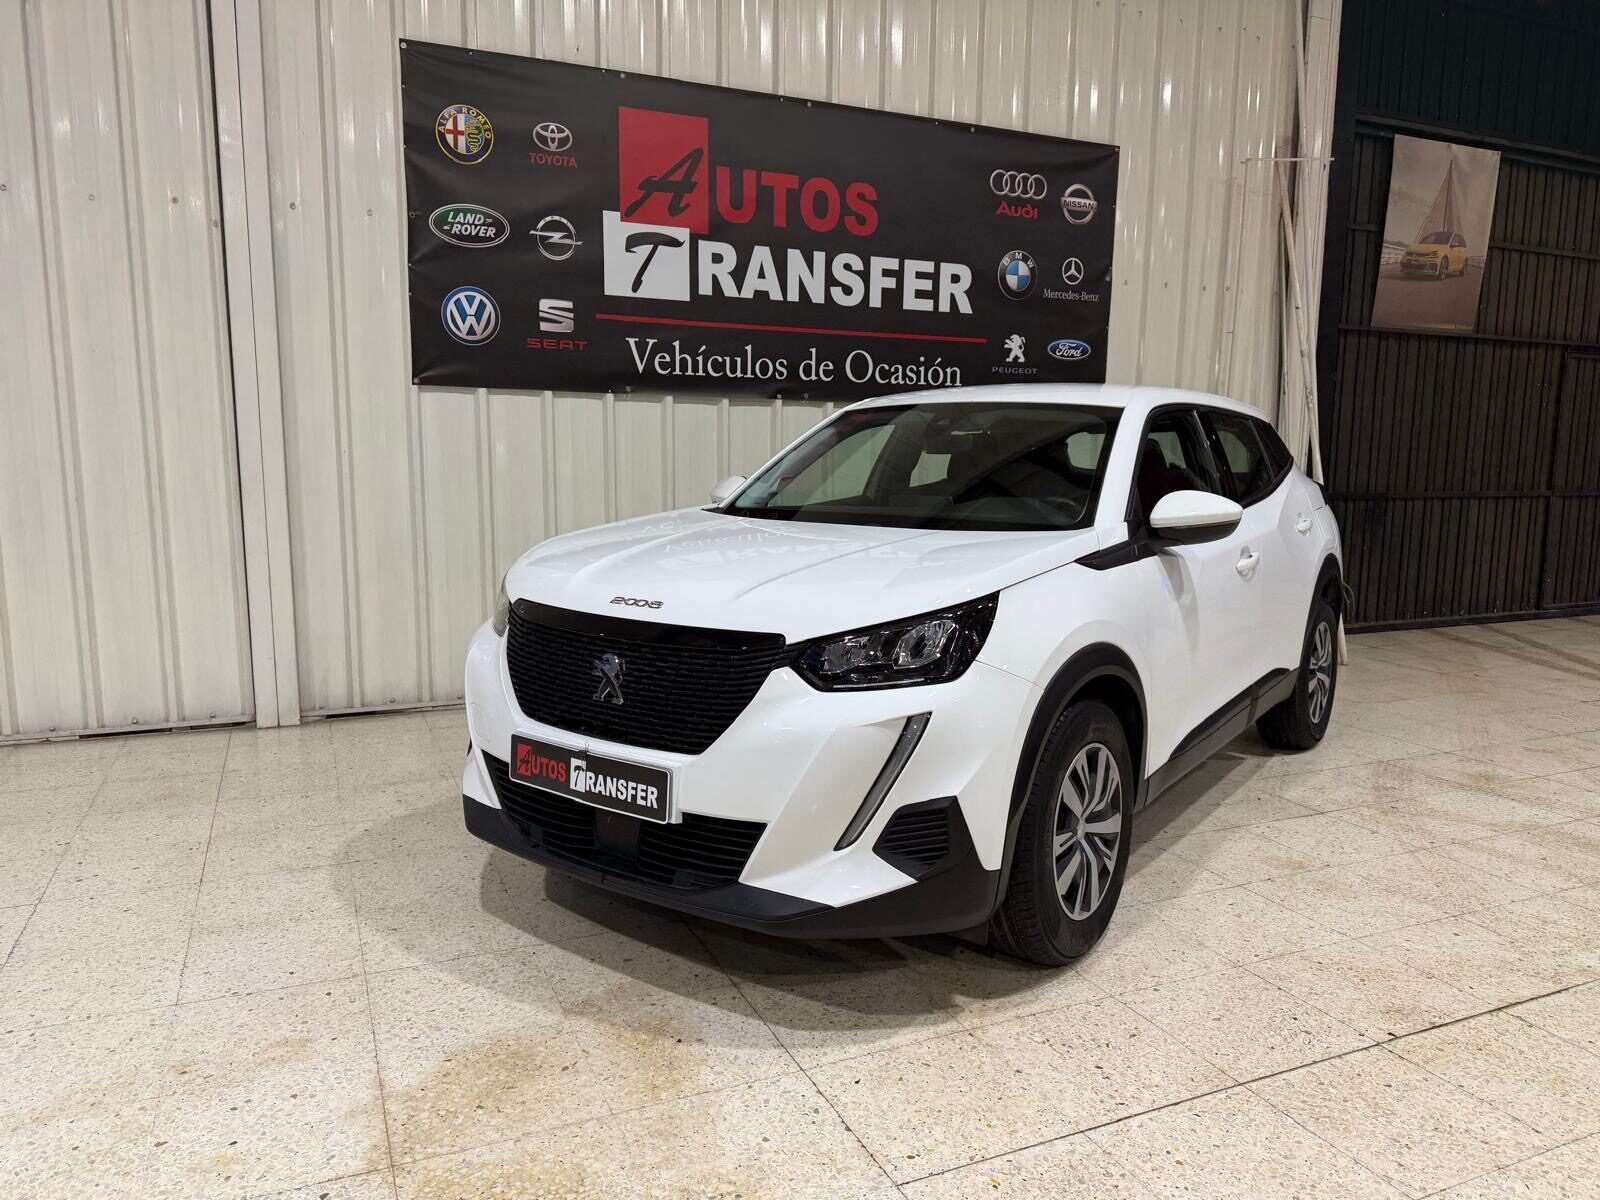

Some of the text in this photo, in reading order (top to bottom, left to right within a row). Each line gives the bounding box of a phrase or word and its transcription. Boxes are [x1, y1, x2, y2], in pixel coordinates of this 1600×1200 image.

[438, 107, 491, 139] ALFA ROMEO
[529, 152, 577, 168] TOYOTA
[623, 147, 879, 237] AUTOS
[995, 200, 1039, 219] Audi
[1063, 200, 1095, 210] NISSAN
[447, 211, 485, 225] LAND
[451, 223, 496, 238] ROVER
[624, 231, 974, 314] TRANSFER
[1043, 288, 1100, 302] Mercedes-Benz
[527, 337, 588, 351] SEAT
[1055, 342, 1083, 357] Ford
[625, 336, 963, 387] Vehículos de Ocasión
[992, 366, 1038, 375] PEUGEOT
[610, 596, 664, 609] 2008
[517, 747, 659, 809] AUTOS TRANSFER
